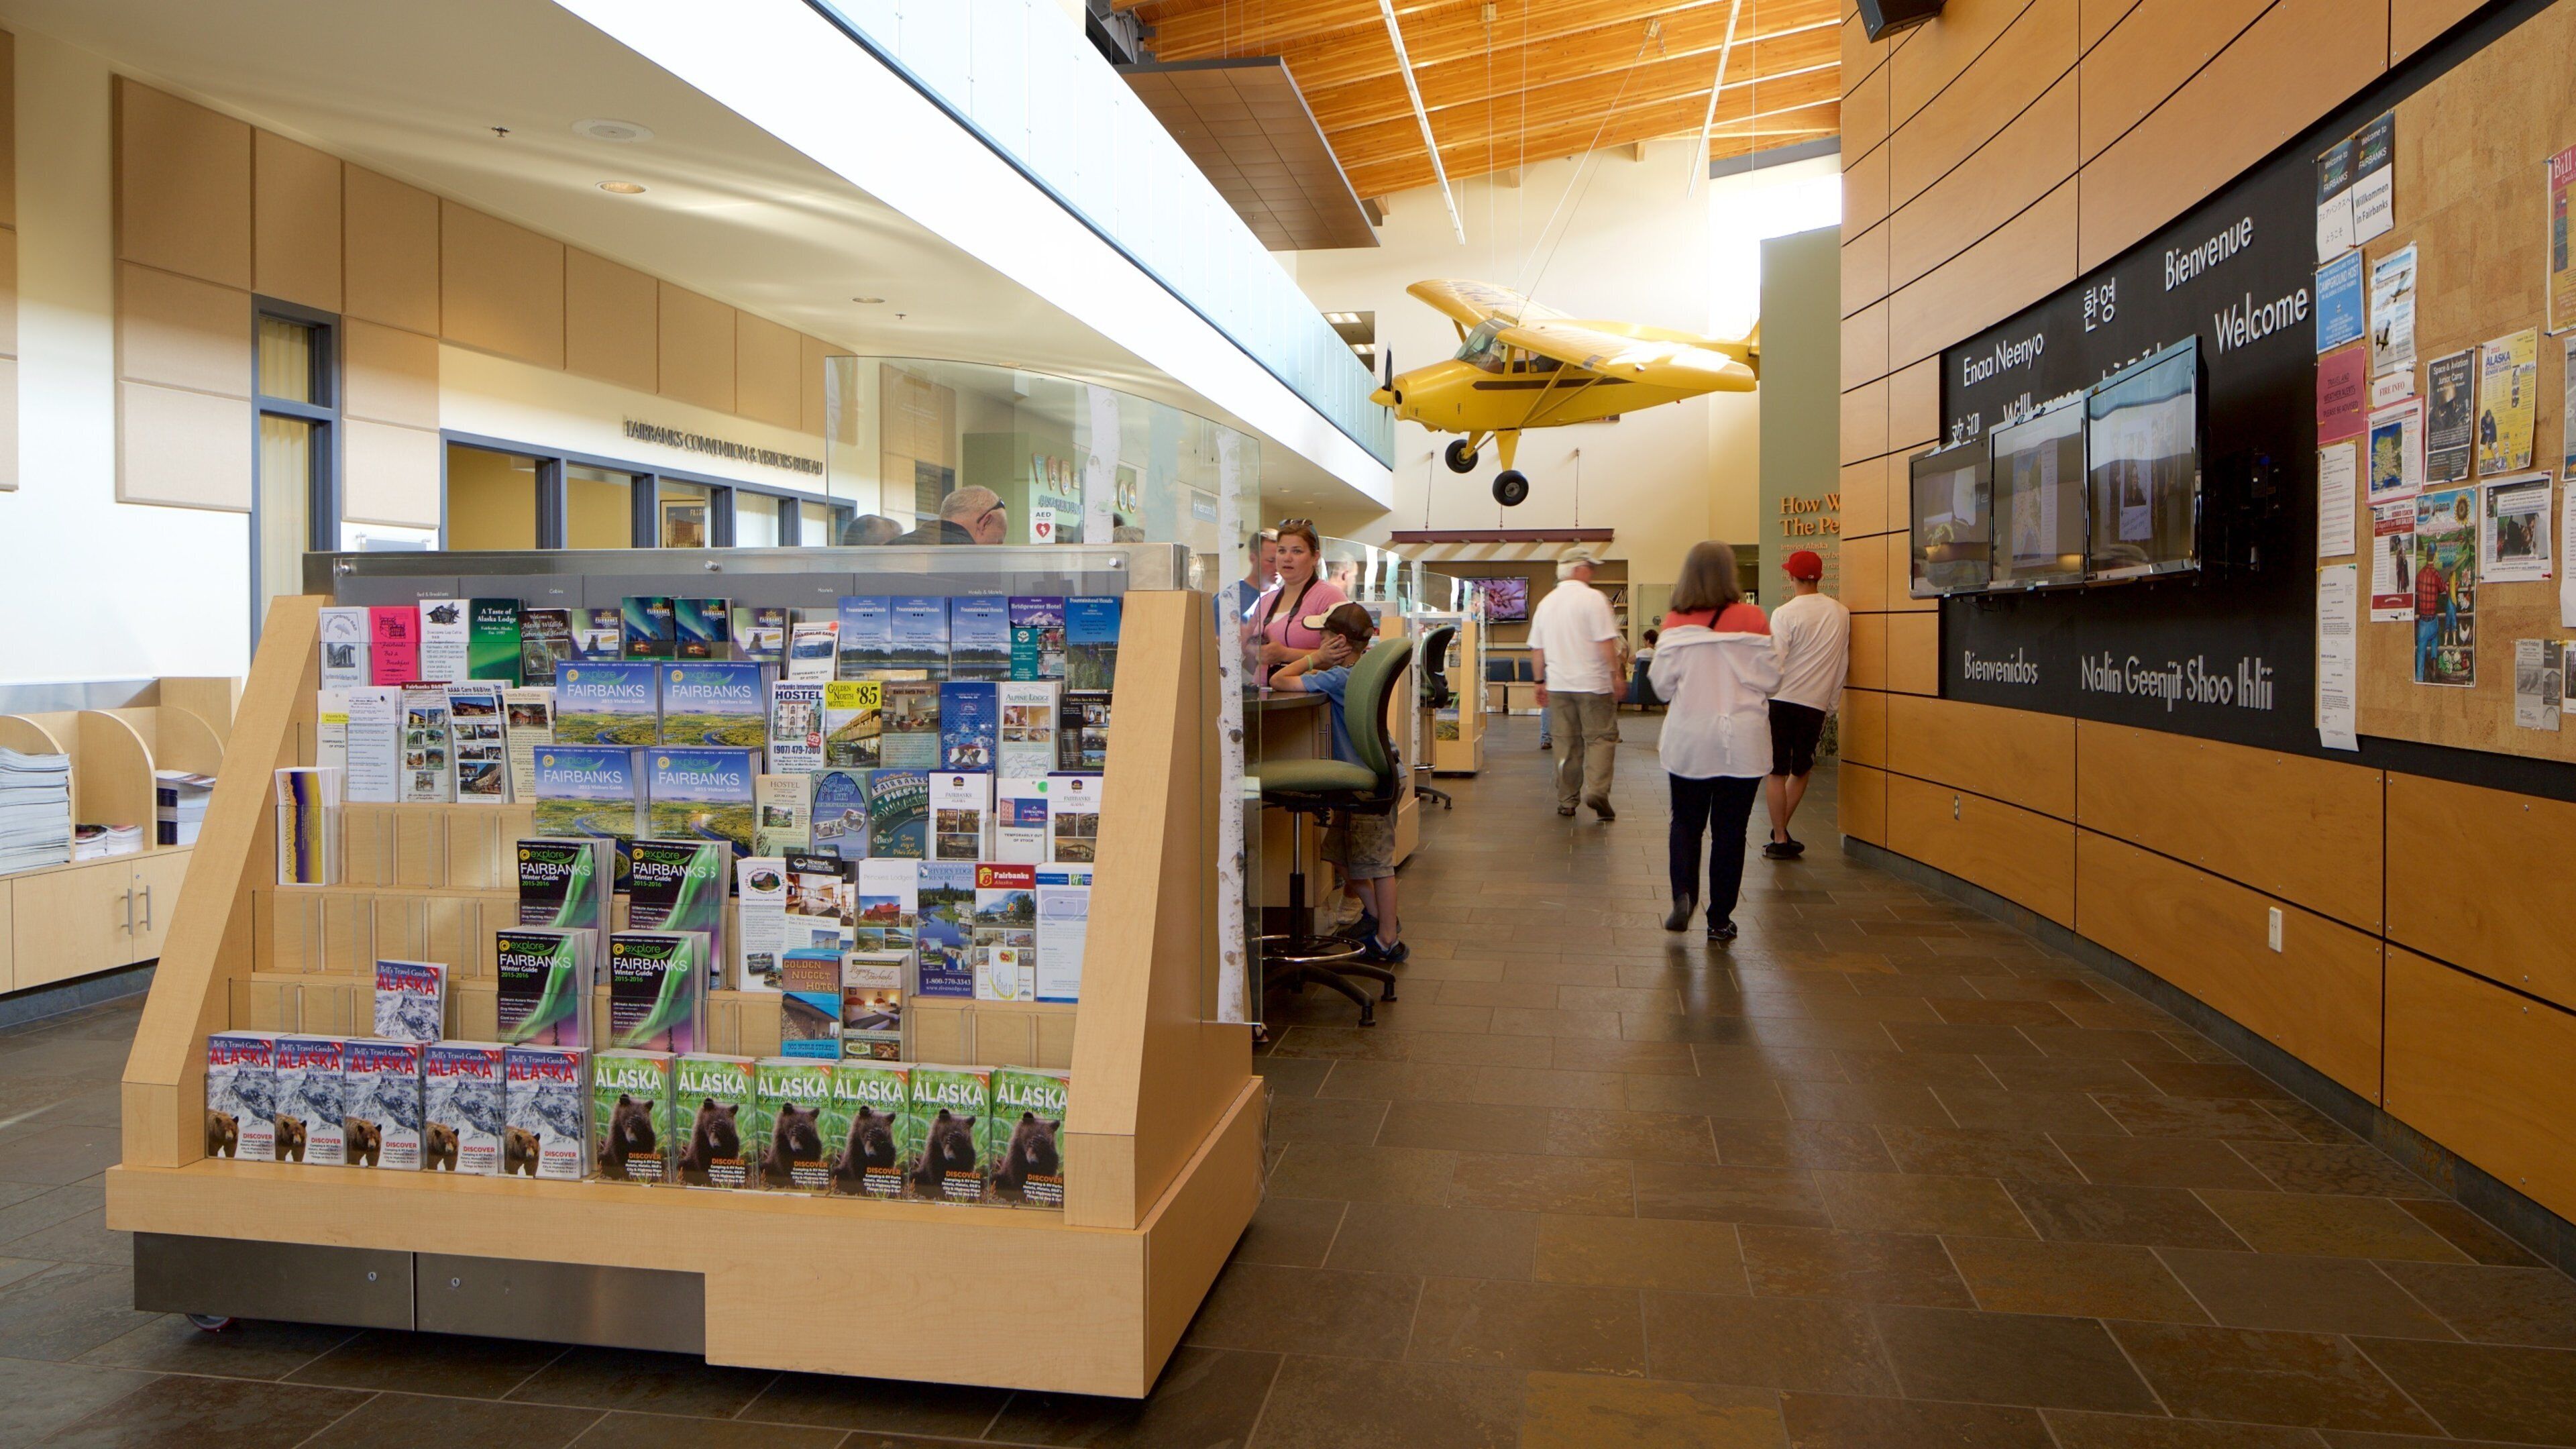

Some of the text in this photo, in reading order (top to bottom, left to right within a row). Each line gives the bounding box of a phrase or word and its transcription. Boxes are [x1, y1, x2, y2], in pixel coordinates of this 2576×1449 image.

[2361, 125, 2387, 146] Welcome to
[2324, 154, 2342, 169] Welcome
[2359, 147, 2387, 170] FAIRBANKS
[2554, 150, 2572, 178] Bill
[2324, 171, 2348, 193] FAIRBANKS
[2356, 183, 2388, 207] Willkommen
[2357, 200, 2388, 224] in Fairbanks
[2165, 216, 2253, 291] Bienvenue
[2319, 270, 2347, 294] CAMPGROUND
[2348, 264, 2359, 279] HOST
[2084, 277, 2116, 332] 환영
[2214, 288, 2308, 354] Welcome
[1964, 333, 2043, 387] Enaa Neenyo
[2486, 352, 2510, 366] ALASKA
[2433, 366, 2445, 375] Space
[2451, 360, 2469, 370] Aviation
[2438, 372, 2463, 385] Junior Camp
[2324, 386, 2355, 401] WEATHER ALERTS
[2379, 382, 2404, 396] FIRE INFO
[2323, 408, 2336, 417] PLEASE
[626, 420, 822, 475] FAIRBANKS CONVENTION & VISITORS BUREAU
[1779, 493, 1840, 515] How W
[1779, 517, 1839, 536] The Pe
[498, 616, 516, 624] Lodge
[1964, 647, 2038, 684] Bienvenidos
[578, 669, 616, 682] explore
[683, 670, 722, 682] explore
[2082, 651, 2122, 692] Nalin
[2186, 655, 2233, 704] Shoo
[567, 685, 645, 697] FAIRBANKS
[672, 685, 751, 698] FAIRBANKS
[775, 691, 822, 700] HOSTEL
[828, 684, 851, 692] GOLDEN
[857, 687, 877, 704] $85
[834, 692, 854, 700] NORTH
[774, 745, 820, 754] (907) 479-7300
[555, 756, 592, 768] explore
[543, 771, 622, 784] FAIRBANKS
[658, 772, 739, 786] FAIRBANKS
[770, 781, 800, 789] HOSTEL
[873, 777, 928, 792] FAIRBANKS
[885, 787, 916, 801] PIKE'S
[521, 863, 590, 876] FAIRBANKS
[633, 862, 706, 878] FAIRBANKS
[500, 954, 571, 968] FAIRBANKS
[614, 957, 687, 971] FAIRBANKS
[784, 961, 820, 969] GOLDEN
[411, 969, 431, 977] Guides
[377, 975, 435, 995] ALASKA
[806, 981, 838, 991] HOTEL
[246, 1042, 264, 1050] Guides
[314, 1044, 335, 1053] Guides
[370, 1049, 388, 1057] Travel
[388, 1049, 409, 1057] Guides
[210, 1049, 270, 1067] ALASKA
[277, 1052, 340, 1070] ALASKA
[351, 1055, 415, 1074] ALASKA
[428, 1059, 493, 1078] ALASKA
[508, 1063, 574, 1082] ALASKA
[595, 1068, 661, 1089] ALASKA
[679, 1071, 747, 1093] ALASKA
[758, 1077, 828, 1097] ALASKA
[834, 1079, 904, 1102] ALASKA
[913, 1081, 985, 1106] ALASKA
[996, 1083, 1067, 1108] ALASKA
